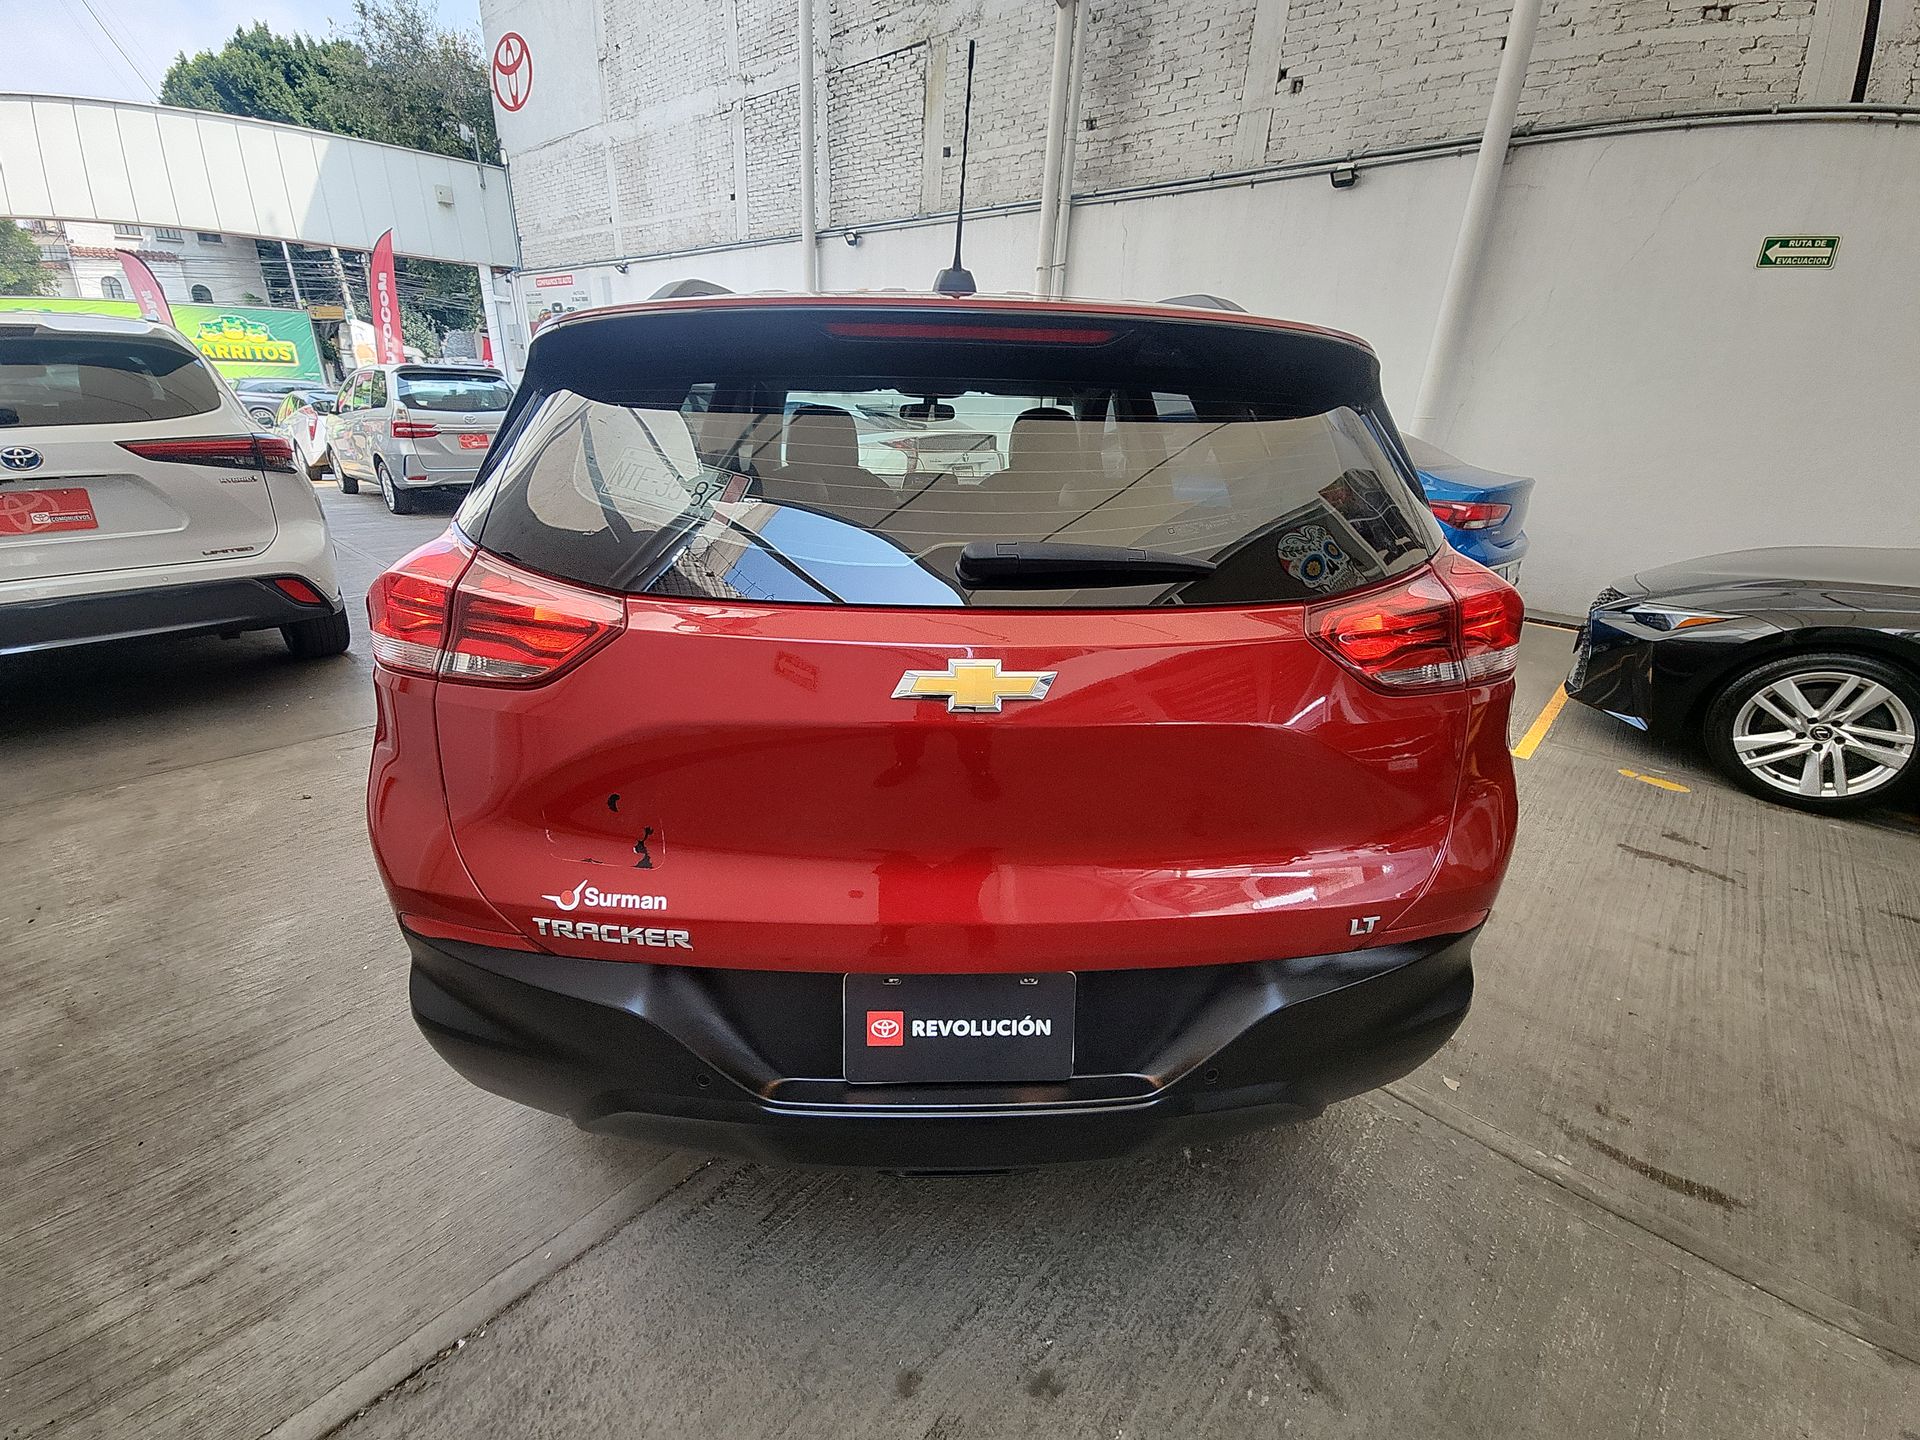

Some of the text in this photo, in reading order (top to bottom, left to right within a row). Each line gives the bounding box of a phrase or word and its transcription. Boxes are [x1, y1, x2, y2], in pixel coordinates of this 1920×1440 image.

[1775, 257, 1829, 265] EVACUACION
[377, 272, 395, 364] UTOCOM
[201, 344, 292, 361] ARRITOS
[584, 887, 667, 910] Surman
[532, 917, 693, 950] TRACKER
[1350, 915, 1381, 936] LT
[911, 1015, 1051, 1037] REVOLUCIÓN
